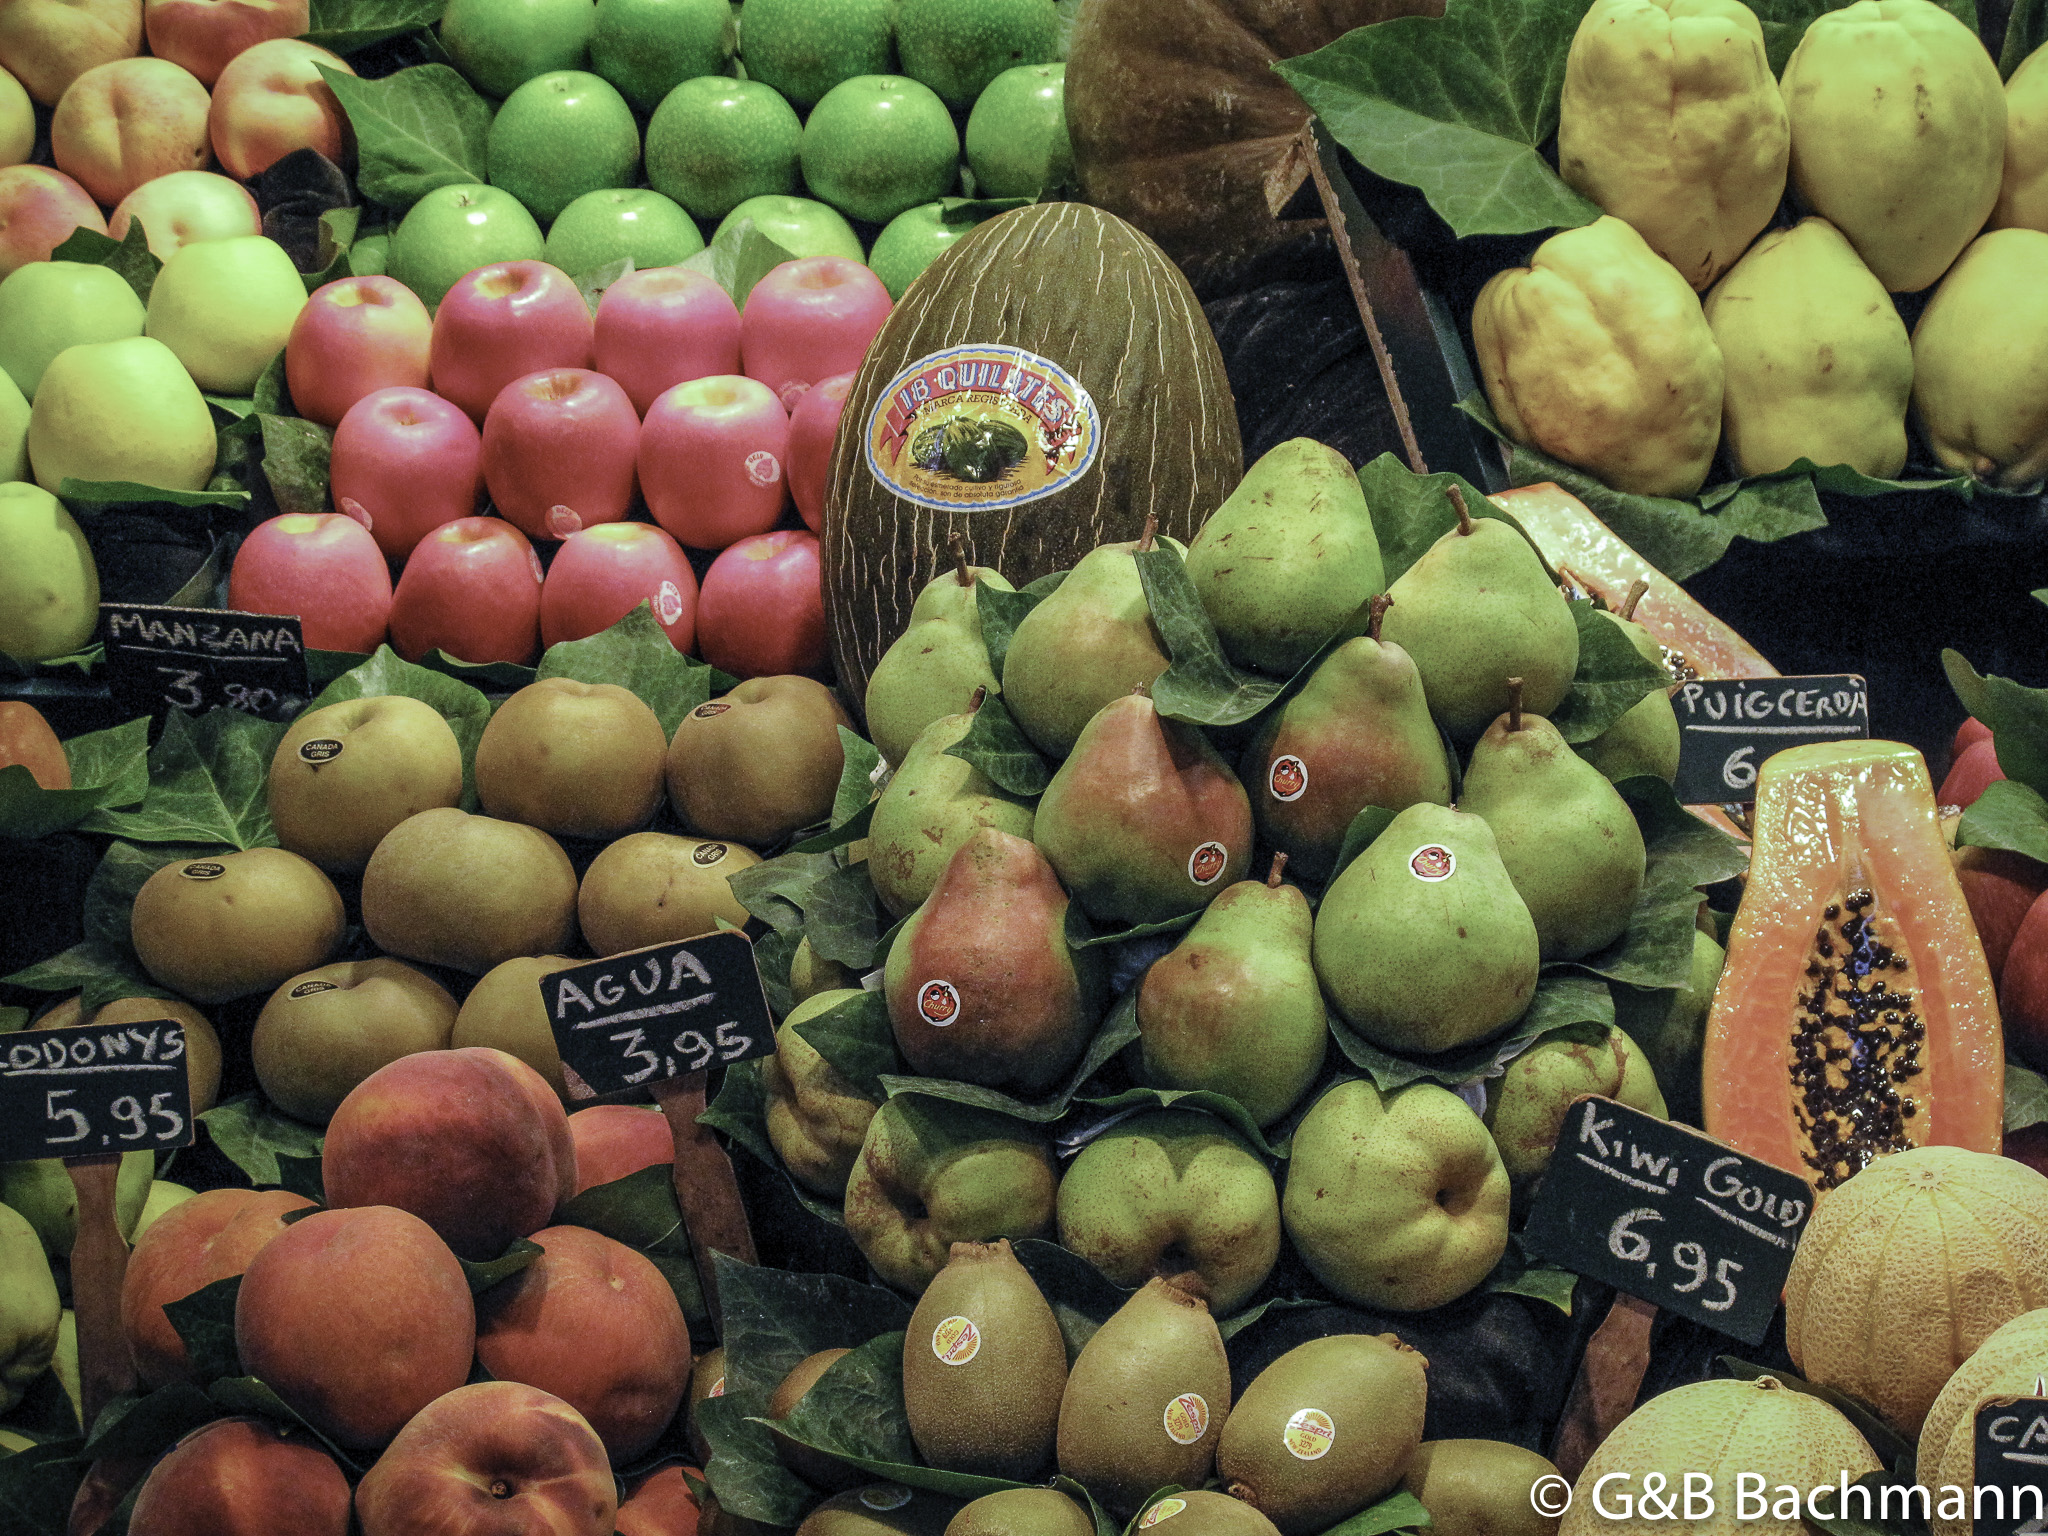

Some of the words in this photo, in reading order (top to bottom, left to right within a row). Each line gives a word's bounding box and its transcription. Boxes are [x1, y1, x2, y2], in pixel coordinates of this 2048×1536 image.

[938, 363, 1069, 422] QUILATES
[110, 613, 301, 653] MANZANA
[306, 743, 339, 751] CANADA
[311, 750, 330, 758] GRIS
[557, 949, 712, 1019] AGUA
[924, 999, 953, 1015] Churry
[0, 1026, 185, 1069] ODONYS
[609, 1020, 753, 1084] 3,95
[1608, 1207, 1744, 1312] 6,95
[945, 1323, 976, 1361] Zespri
[1168, 1420, 1186, 1440] ZEALAND
[1178, 1396, 1202, 1438] Zespri
[1179, 1411, 1190, 1429] GOLD
[1296, 1446, 1322, 1458] ZEALAND
[1298, 1439, 1313, 1450] 3279
[1299, 1432, 1317, 1444] GOLD
